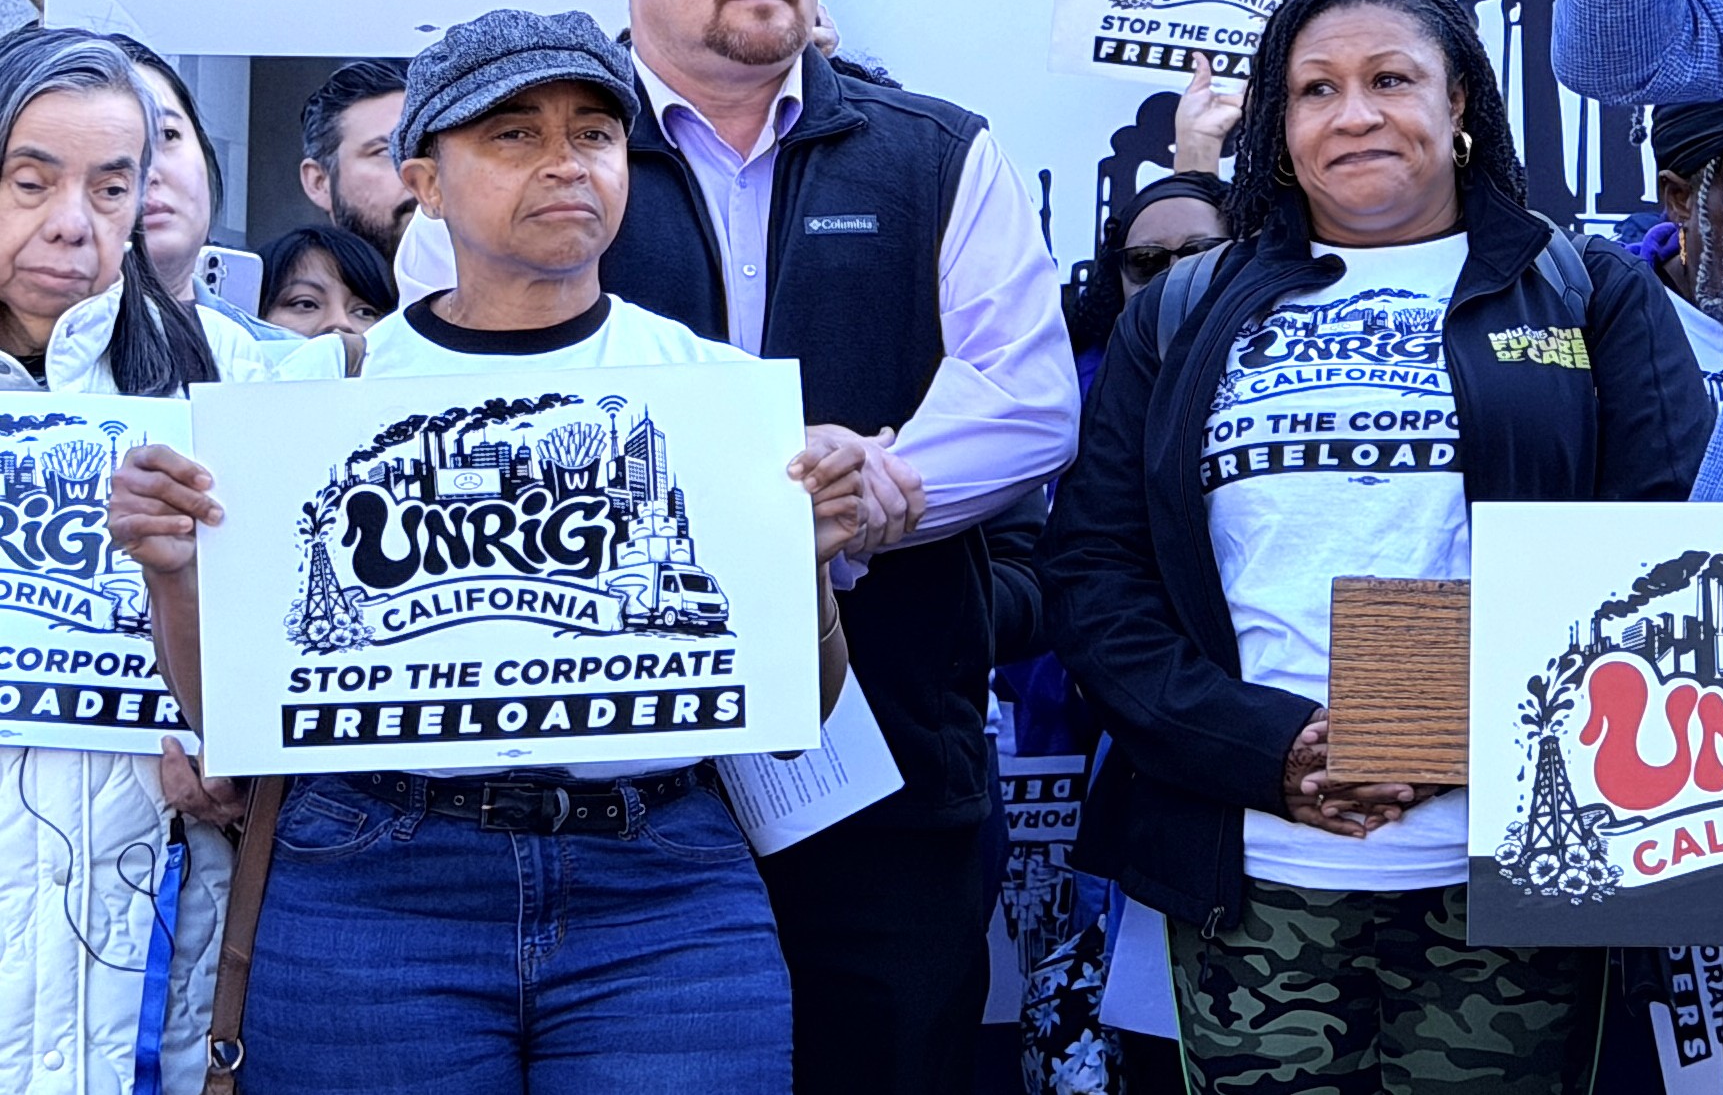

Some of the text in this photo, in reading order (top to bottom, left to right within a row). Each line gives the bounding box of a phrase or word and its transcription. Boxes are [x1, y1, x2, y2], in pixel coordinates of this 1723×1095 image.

[1101, 15, 1161, 36] STOP
[1168, 22, 1210, 42] THE
[1099, 40, 1251, 76] FREEOA
[821, 218, 874, 231] Columbia
[1491, 336, 1587, 354] FUTURE
[1496, 348, 1591, 369] OF CARE
[1250, 367, 1440, 395] CALIFORNIA
[1266, 412, 1337, 434] THE
[382, 587, 600, 632] CALIFORNIA
[287, 648, 736, 694] STOP THE CORPORATE
[292, 691, 741, 739] FREELOADERS
